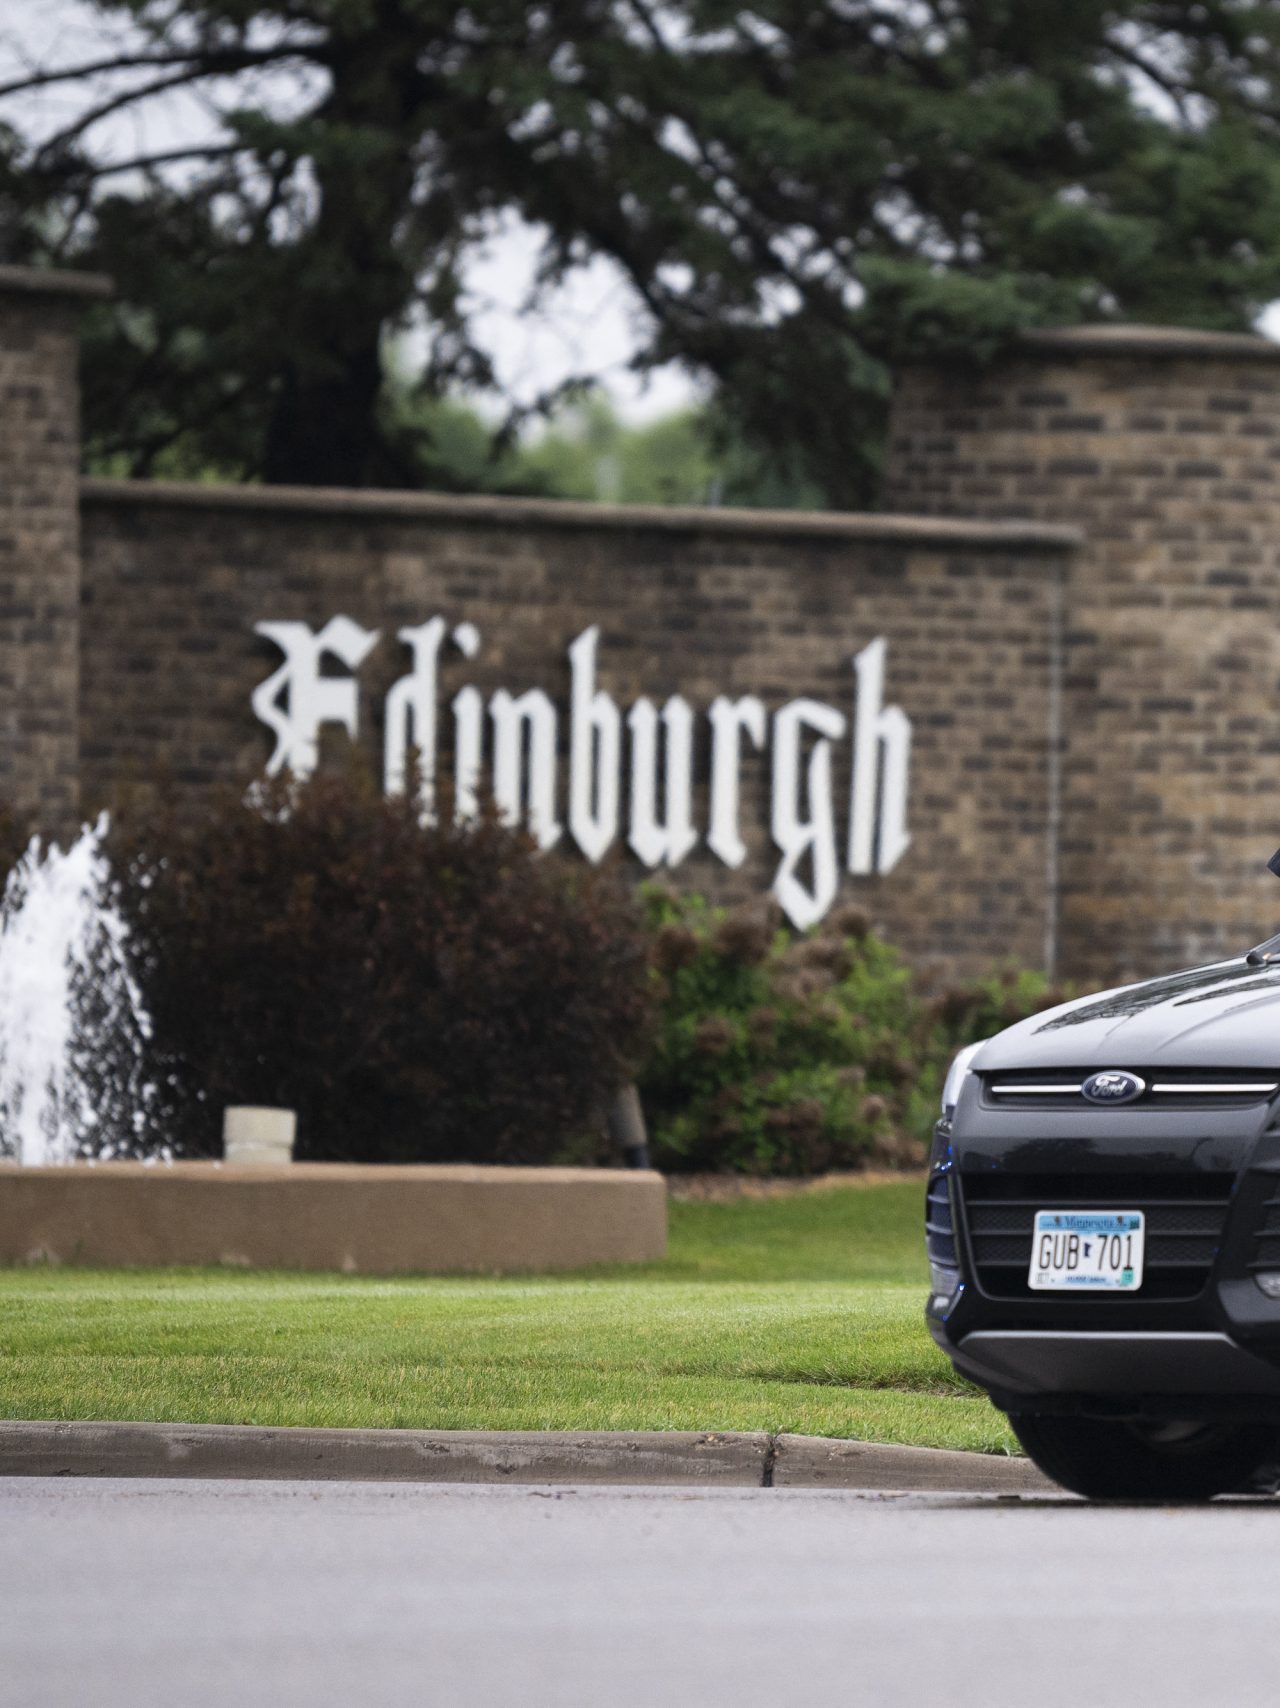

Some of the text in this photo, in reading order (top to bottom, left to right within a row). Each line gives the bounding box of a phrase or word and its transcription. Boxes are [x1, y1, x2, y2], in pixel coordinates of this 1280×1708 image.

[244, 614, 913, 932] Edinburgh
[1091, 1074, 1128, 1097] Ford
[1039, 1233, 1134, 1271] GUB 701
